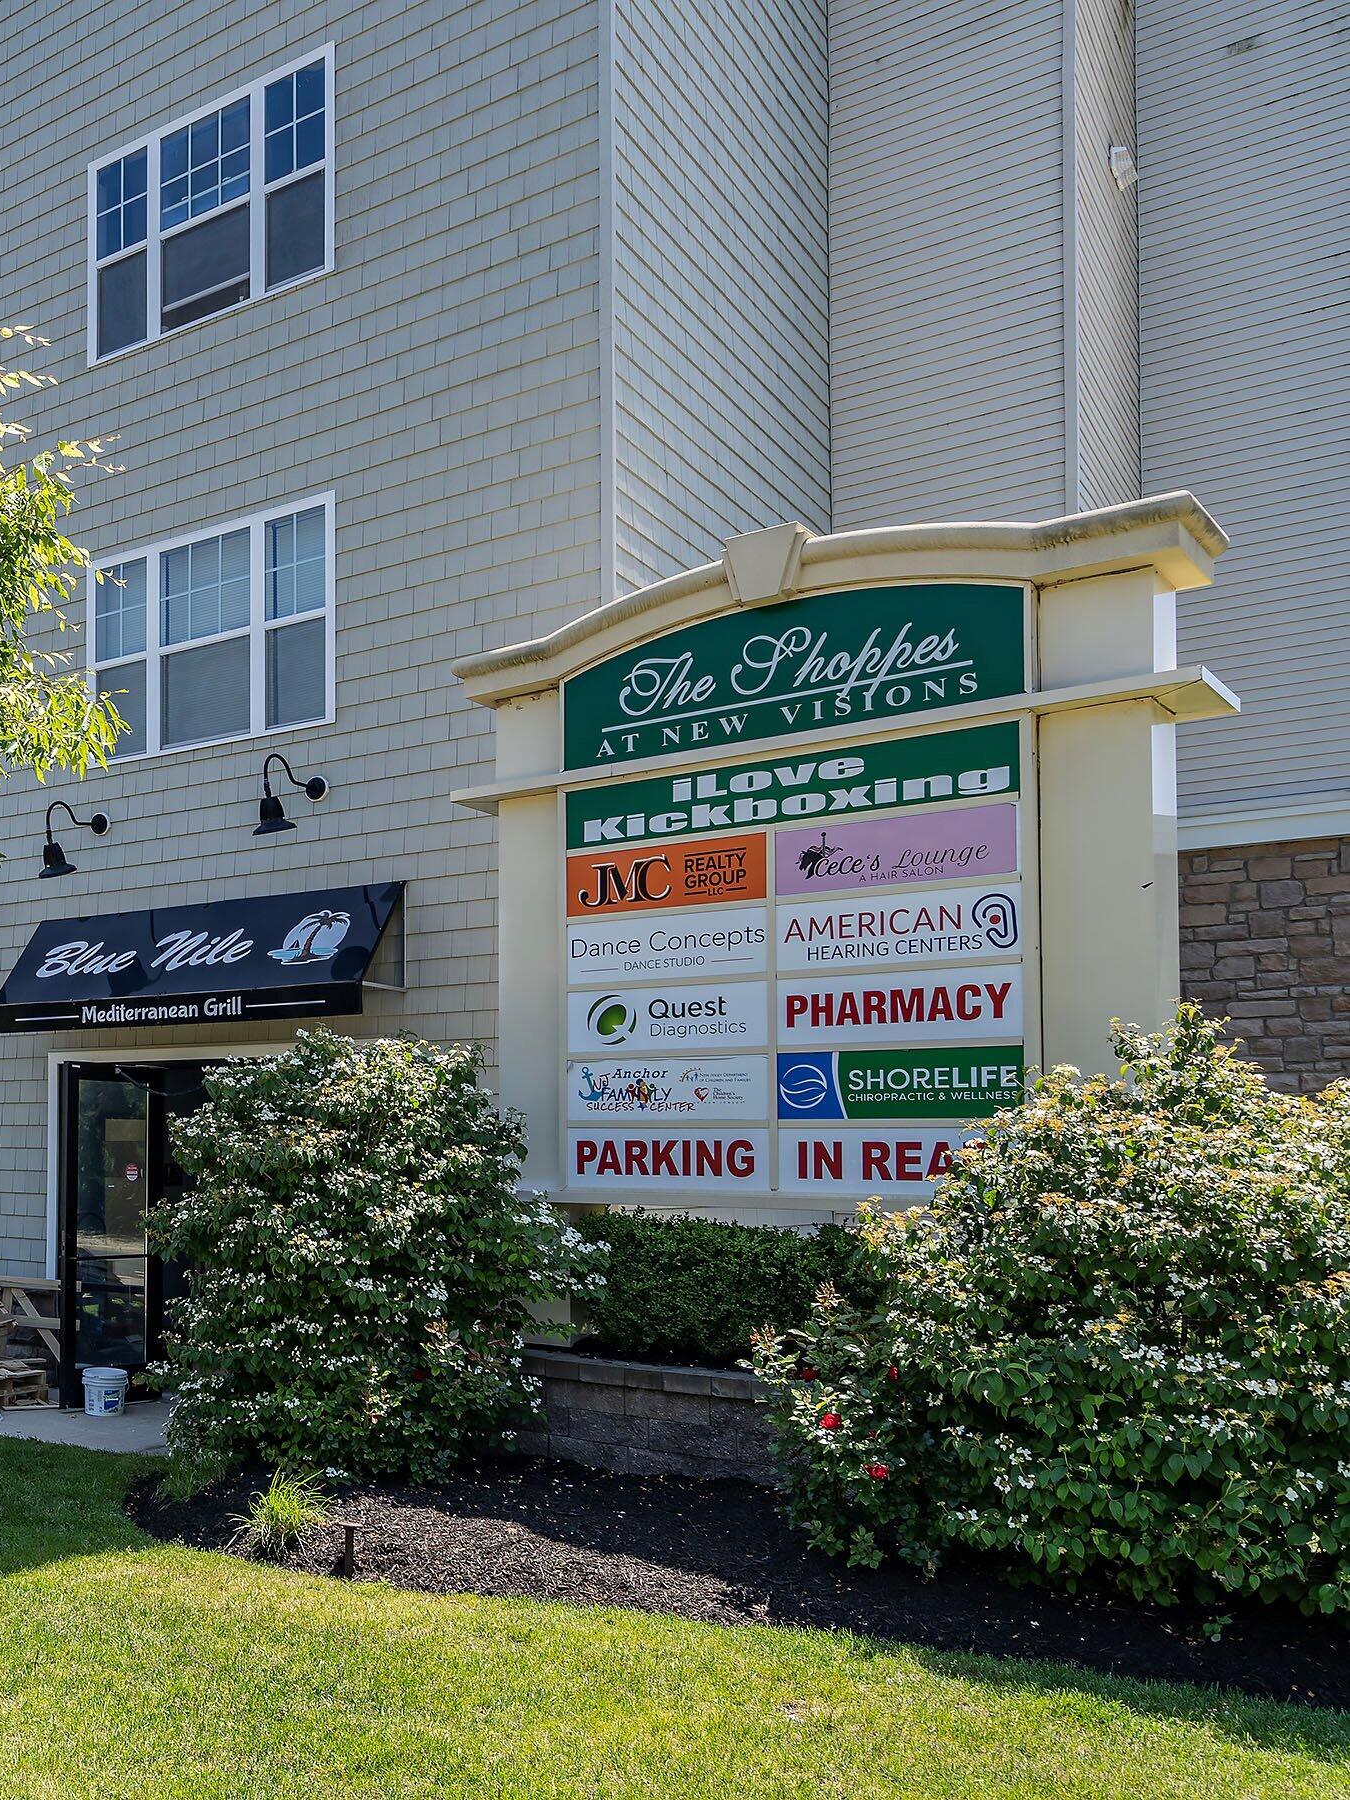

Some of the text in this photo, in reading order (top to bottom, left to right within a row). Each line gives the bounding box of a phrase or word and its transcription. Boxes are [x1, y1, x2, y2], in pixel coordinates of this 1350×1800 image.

[619, 622, 959, 716] The Shoppes
[595, 672, 979, 759] AT NEW VISIONS
[671, 757, 865, 803] iLove
[582, 765, 1011, 844] Kickboxing
[684, 851, 747, 873] REALTY
[892, 844, 990, 869] Lounge
[578, 854, 672, 908] JMC
[684, 868, 747, 889] GROUP
[859, 865, 944, 883] A HAIR SALON
[707, 887, 724, 896] LLC
[783, 904, 963, 944] AMERICAN
[35, 928, 254, 979] Blue Nile
[571, 926, 766, 959] Dance Concepts
[807, 934, 983, 961] HEARING CENTERS
[624, 955, 705, 971] DANCE STUDIO
[81, 996, 242, 1024] Mediterranean Grill
[648, 996, 728, 1020] Quest
[785, 982, 1013, 1030] PHARMACY
[650, 1020, 747, 1039] Diagnostics
[612, 1067, 669, 1080] Anchor
[848, 1065, 1018, 1090] SHORELIFE
[586, 1101, 696, 1112] SUCCESS CENTER
[847, 1090, 1018, 1102] CHIROPRACTIC & WELLNESS
[576, 1138, 756, 1178] PARKING
[797, 1141, 975, 1181] IN REA
